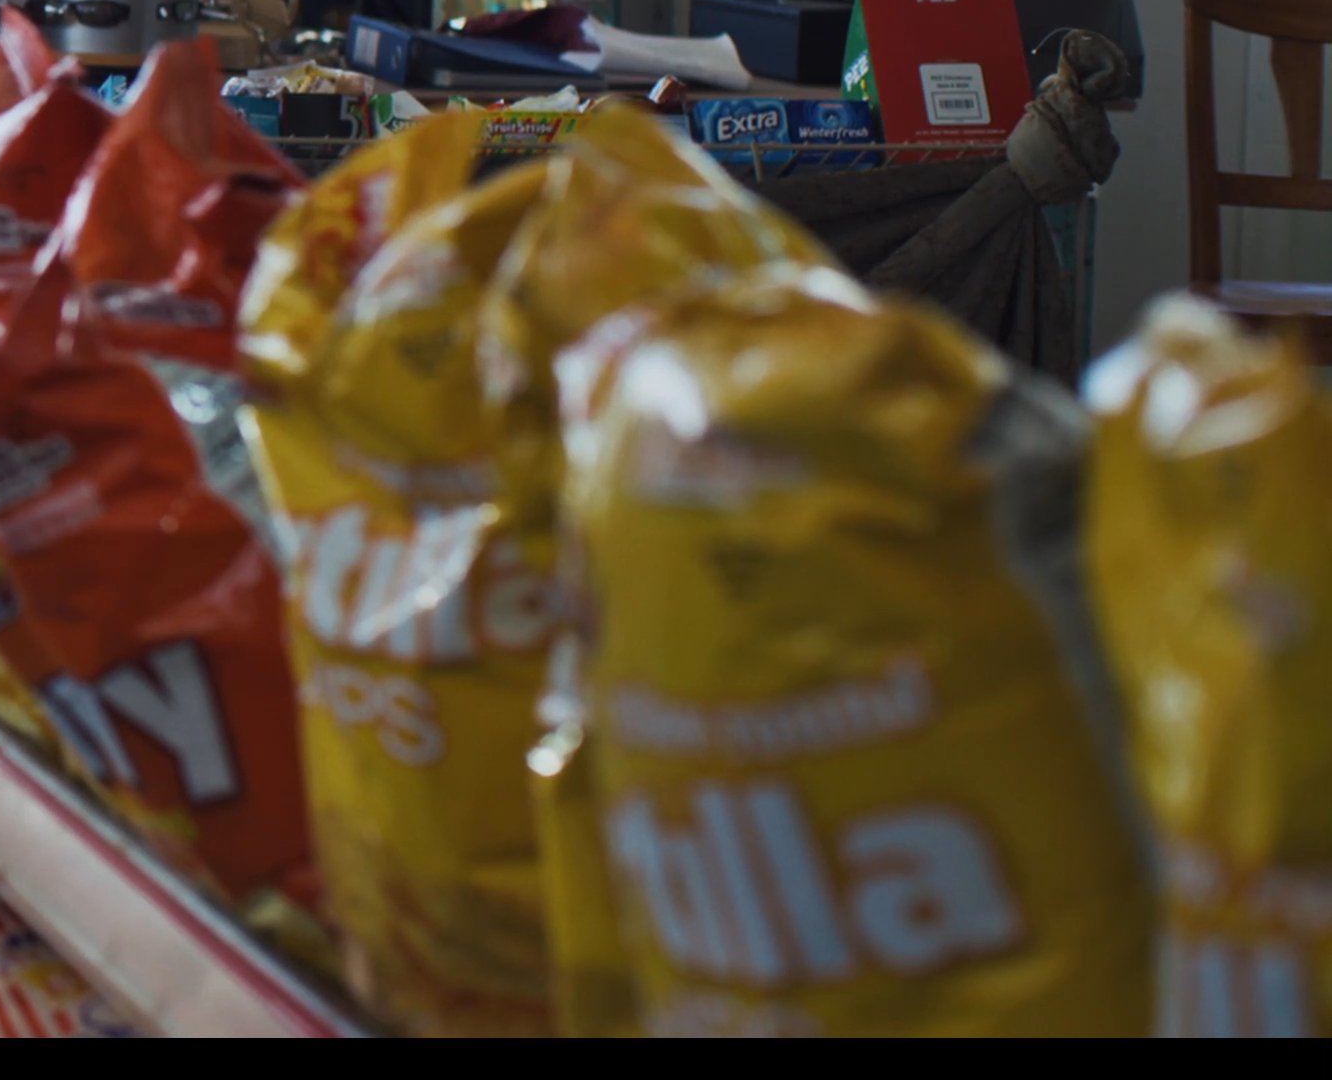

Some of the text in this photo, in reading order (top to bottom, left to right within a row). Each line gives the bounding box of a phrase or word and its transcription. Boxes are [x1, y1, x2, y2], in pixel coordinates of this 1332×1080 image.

[844, 51, 869, 92] PEZ
[717, 109, 779, 141] Extra
[798, 126, 869, 140] Winterfresh
